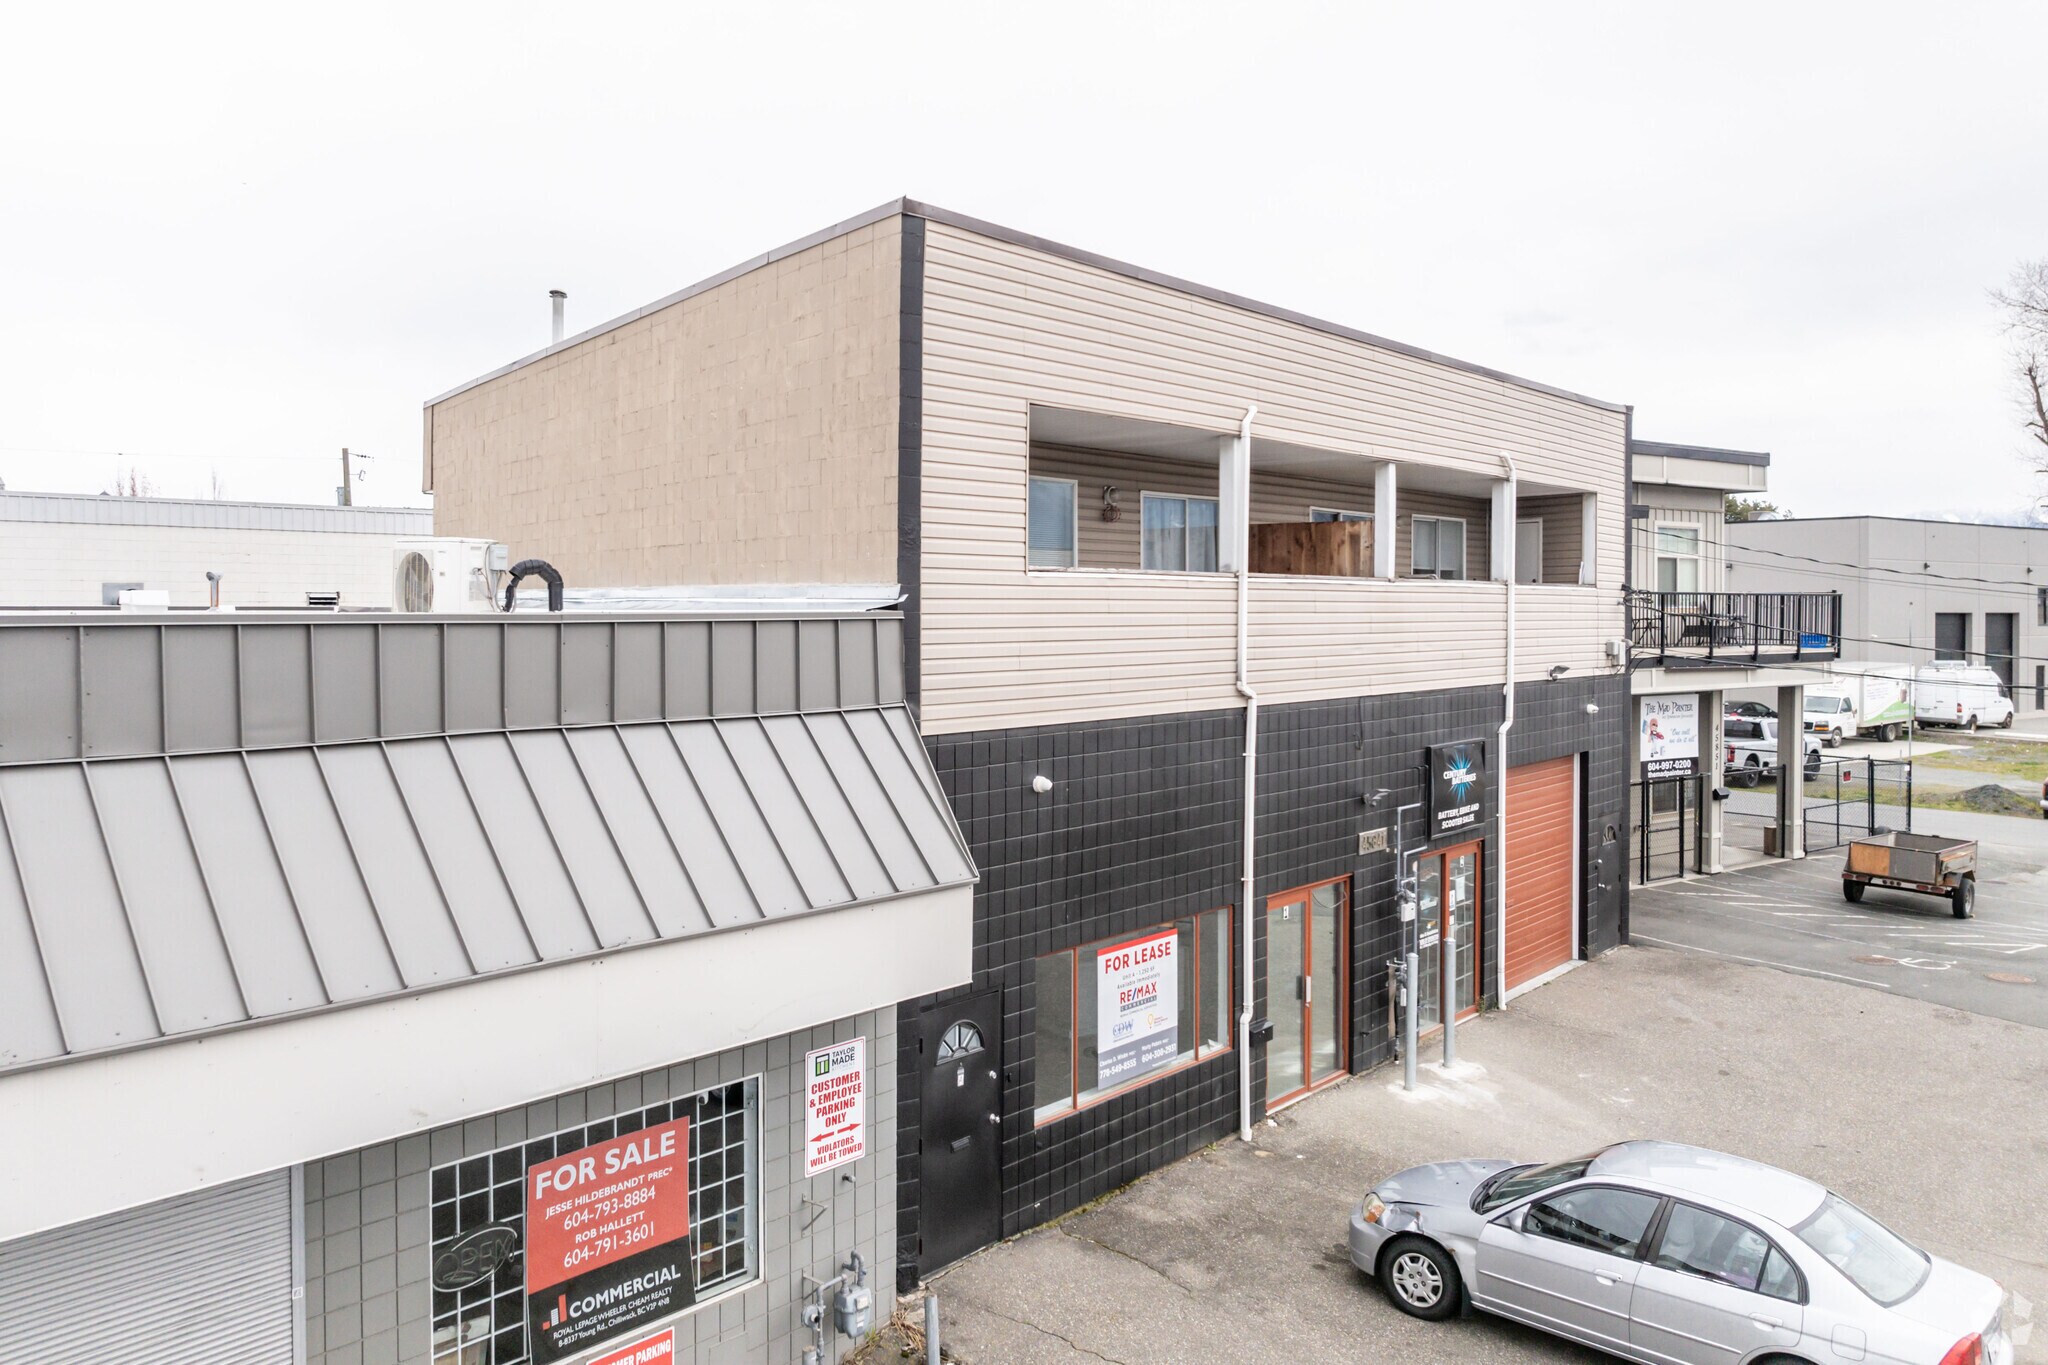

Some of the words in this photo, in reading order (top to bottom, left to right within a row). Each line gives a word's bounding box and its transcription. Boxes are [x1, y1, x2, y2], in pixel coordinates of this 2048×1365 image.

[1443, 768, 1467, 779] CENTURY
[1647, 759, 1692, 771] 604-997-0200
[1647, 768, 1692, 779] themadpainter.ca
[1442, 817, 1463, 829] SCOOTER
[1463, 813, 1475, 824] SALES
[1105, 953, 1130, 974] FOR
[1134, 941, 1171, 965] LEASE
[1120, 981, 1157, 1005] RE/MAX
[831, 1053, 855, 1067] MADE
[832, 1046, 855, 1058] TAYLOR
[809, 1099, 816, 1108] &
[818, 1082, 862, 1105] EMPLOYEE
[811, 1071, 860, 1095] CUSTOMER
[816, 1097, 855, 1118] PARKING
[825, 1112, 847, 1128] ONLY
[810, 1155, 827, 1168] WILL
[828, 1151, 837, 1161] BE
[839, 1142, 863, 1158] TOWED
[817, 1135, 855, 1155] VIOLATORS
[535, 1156, 597, 1200] FOR
[605, 1130, 676, 1174] SALE
[545, 1200, 573, 1220] JESSE
[574, 1174, 645, 1207] HILDEBRANDT
[564, 1185, 656, 1231] 604-793-8884
[575, 1230, 597, 1244] ROB
[600, 1211, 645, 1235] HALLETT
[564, 1221, 655, 1268] 604-791-3601
[434, 1233, 515, 1284] OPEN
[569, 1264, 681, 1318] COMMERCIAL
[553, 1327, 574, 1340] ROYAL
[574, 1316, 598, 1331] LEPAGE
[597, 1304, 627, 1321] WHEELER
[628, 1294, 651, 1310] CHEAM
[651, 1286, 673, 1299] REALTY
[578, 1326, 596, 1339] Young
[608, 1312, 637, 1327] Chilliwack,
[637, 1306, 646, 1316] BC
[646, 1301, 657, 1312] V2P
[635, 1339, 672, 1365] PARKING
